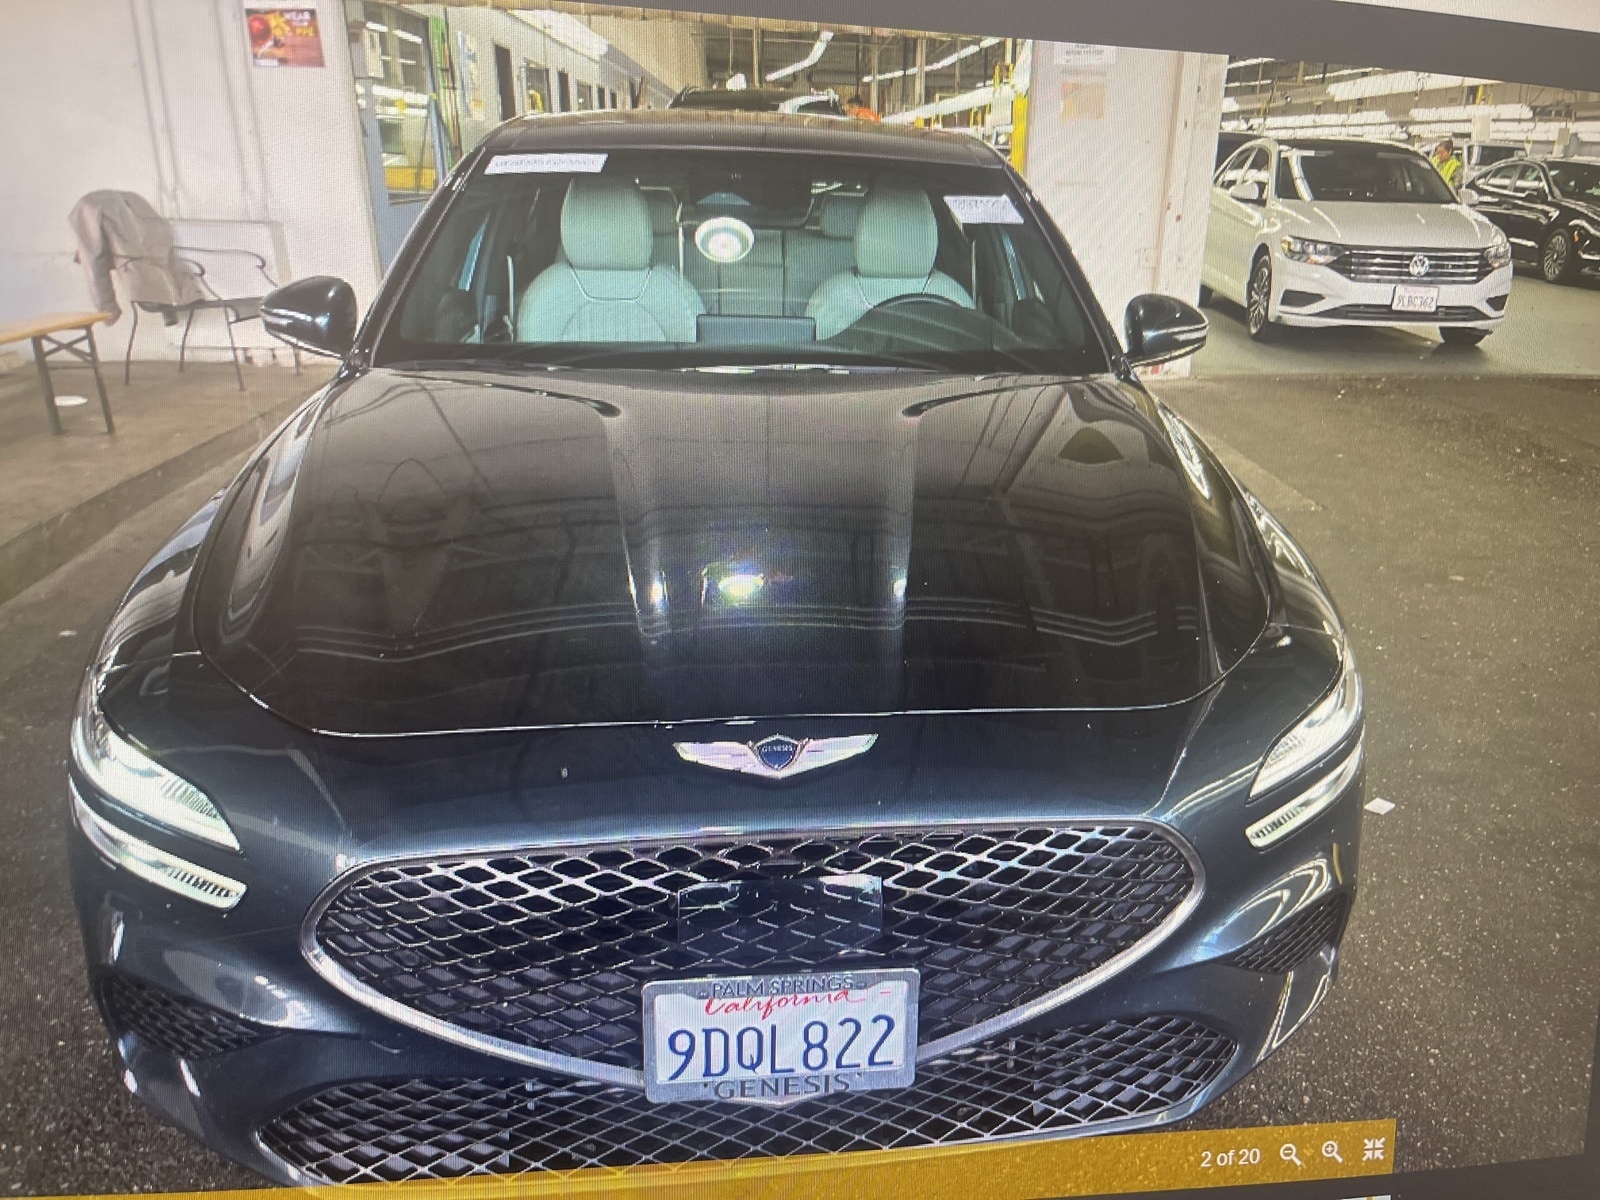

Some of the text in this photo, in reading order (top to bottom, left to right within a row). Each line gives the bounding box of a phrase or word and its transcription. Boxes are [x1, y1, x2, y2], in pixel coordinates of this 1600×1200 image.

[712, 974, 854, 998] PALM SPRINGS
[705, 988, 860, 1020] California
[668, 1014, 896, 1081] 9DQL822
[713, 1073, 850, 1100] GENESIS
[1200, 1148, 1260, 1167] 2 of 20
